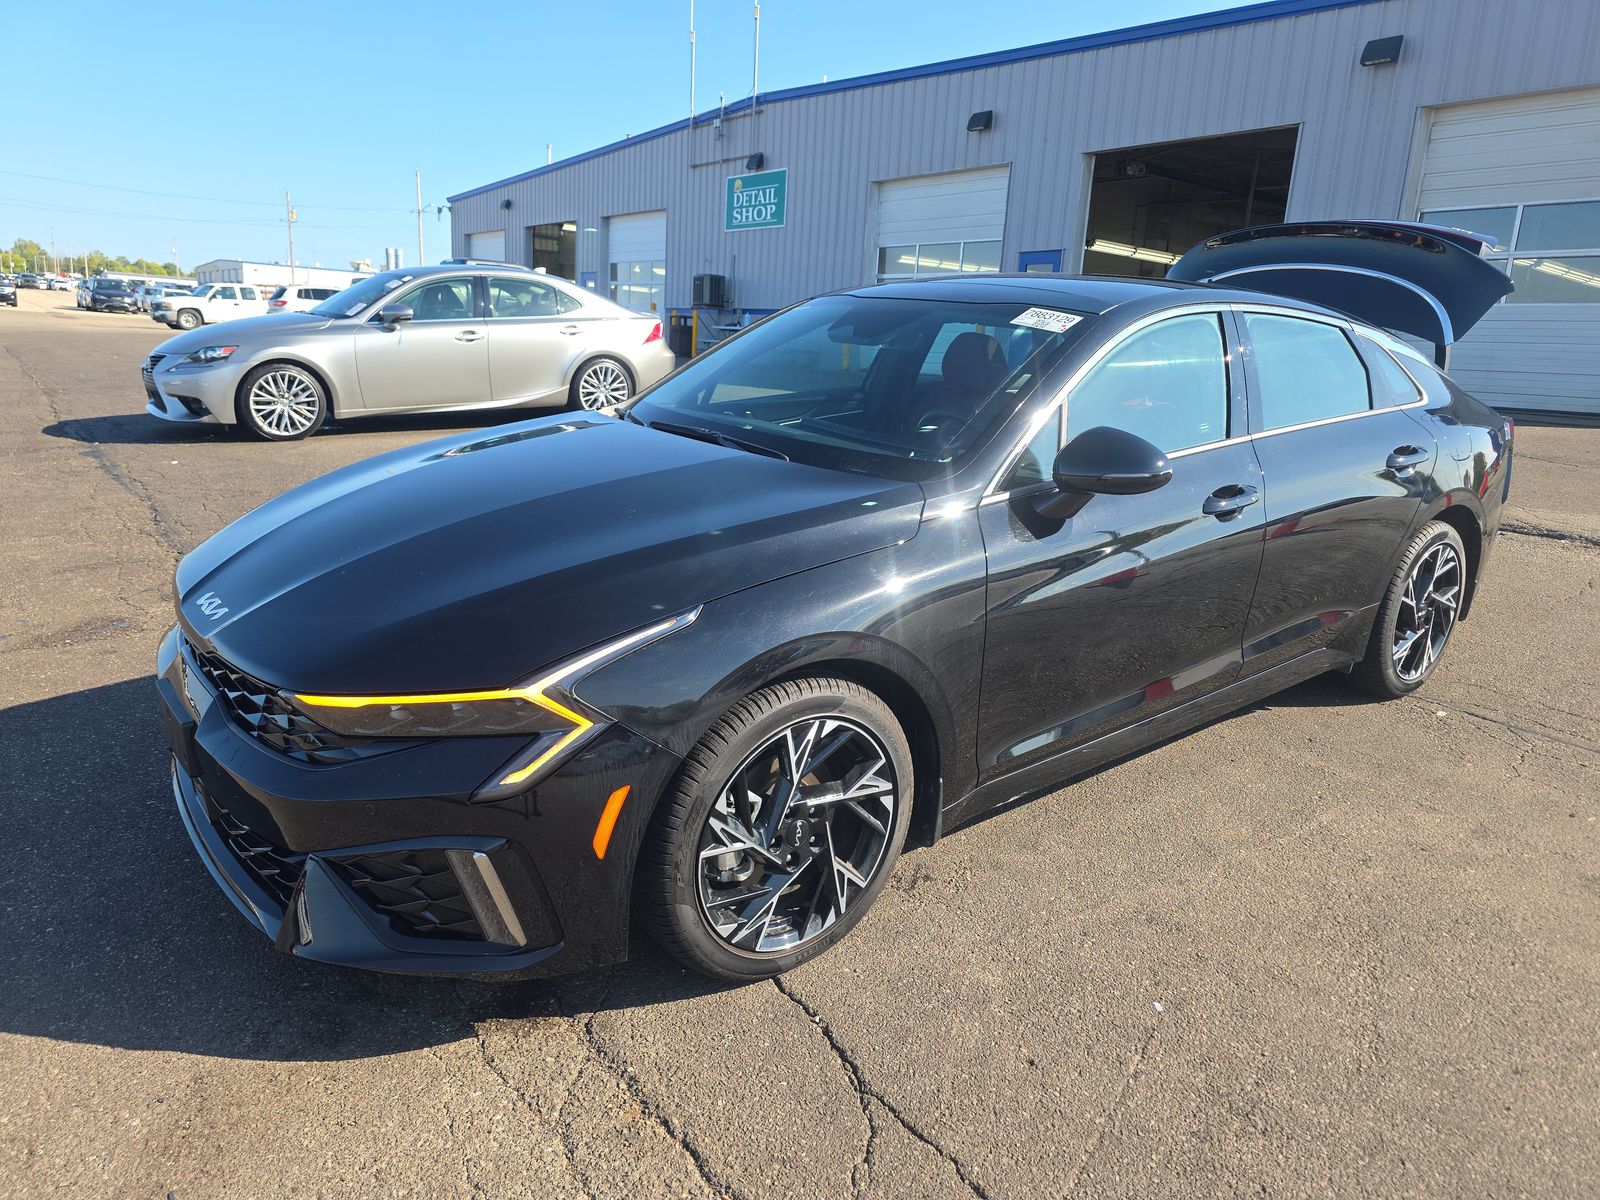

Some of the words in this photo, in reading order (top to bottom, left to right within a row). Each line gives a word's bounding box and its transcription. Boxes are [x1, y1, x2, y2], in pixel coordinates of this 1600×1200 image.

[733, 188, 778, 207] DETAIL
[732, 205, 776, 223] SHOP
[195, 591, 229, 621] KIA
